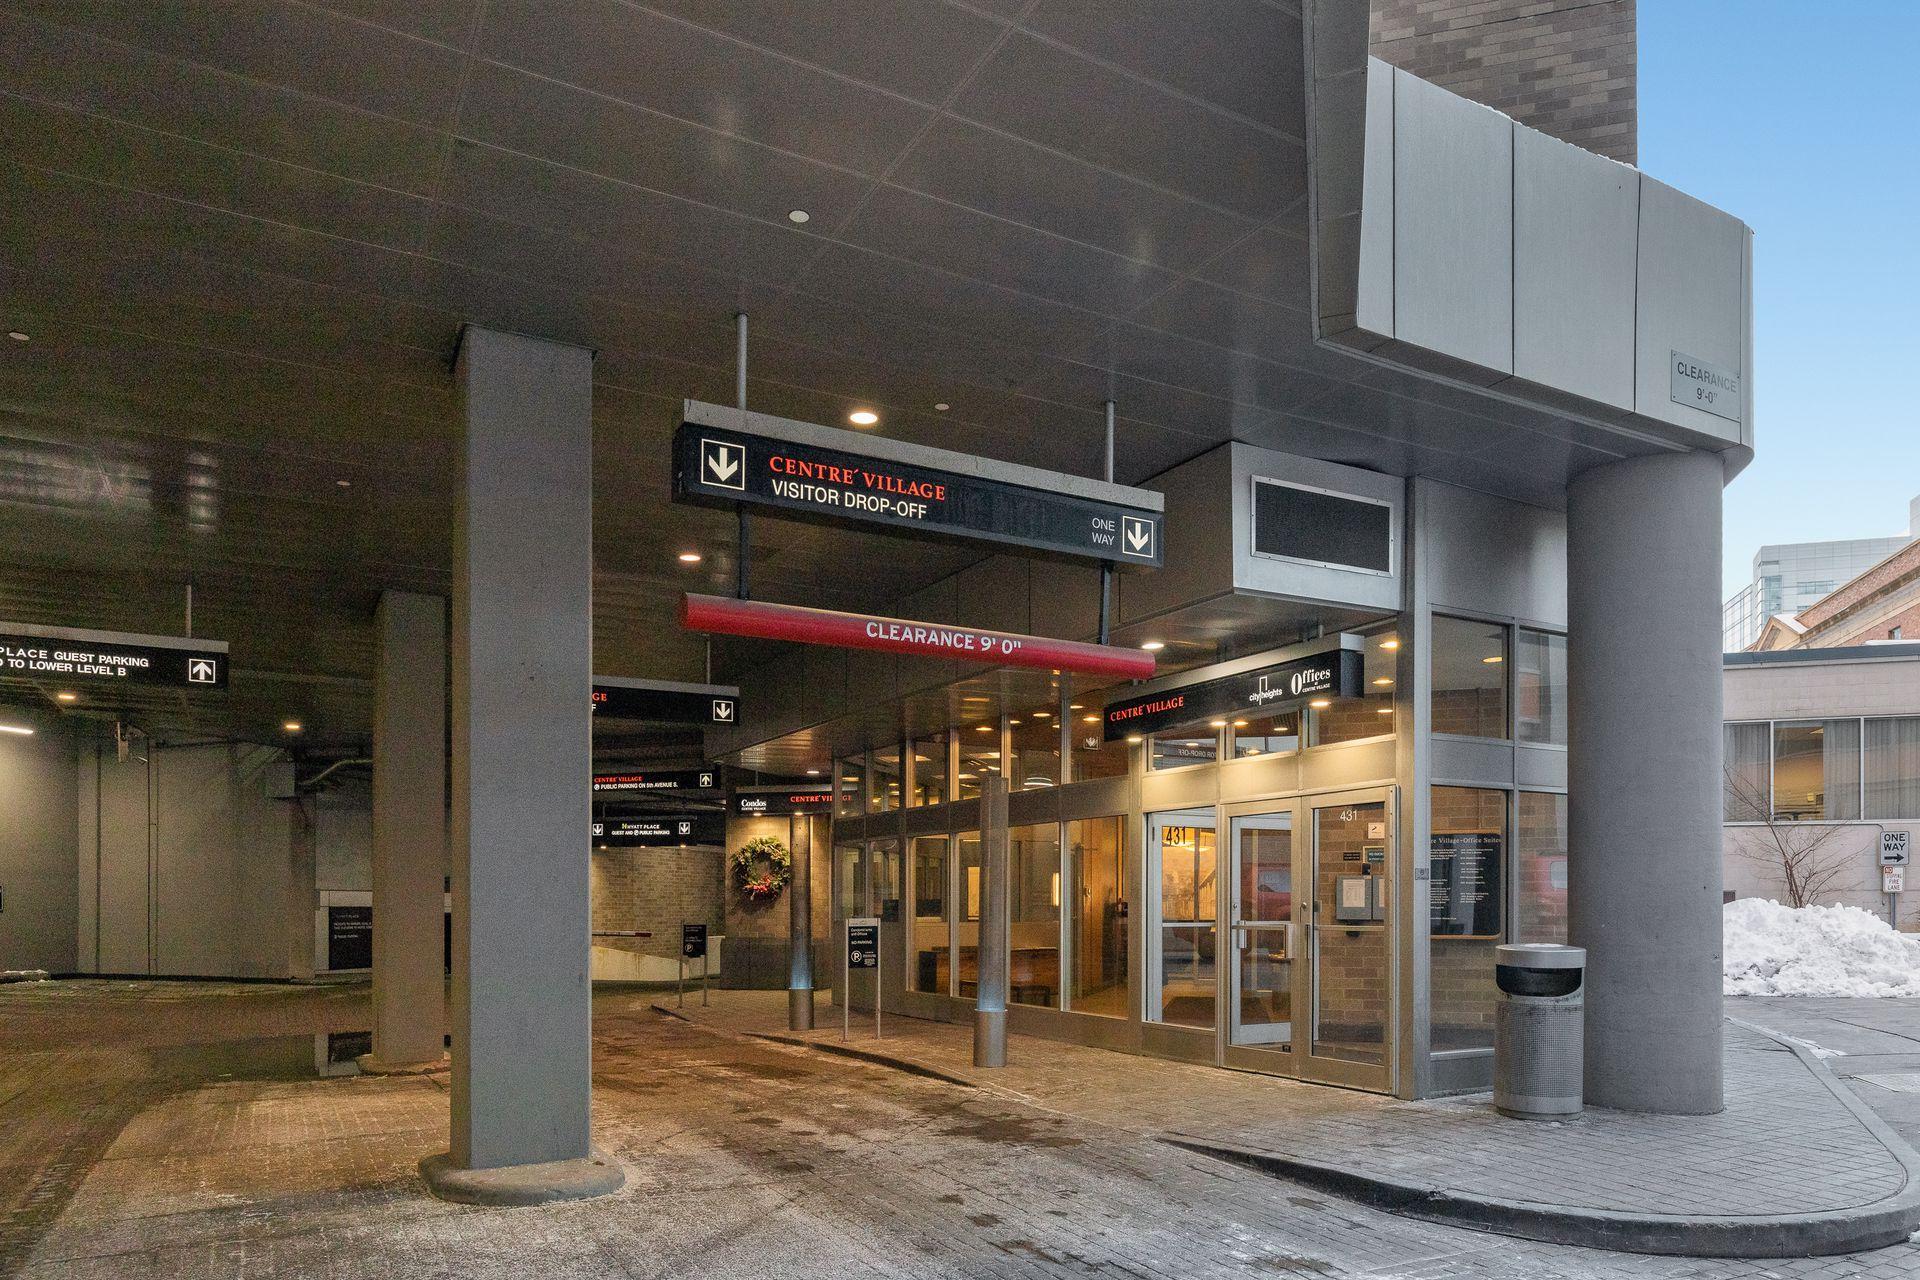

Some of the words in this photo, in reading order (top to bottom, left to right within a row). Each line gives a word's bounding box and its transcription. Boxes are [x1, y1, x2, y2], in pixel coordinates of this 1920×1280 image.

[1677, 361, 1737, 393] CLEARANCE
[862, 471, 945, 501] VILLAGE
[772, 479, 839, 505] VISITOR
[844, 491, 927, 519] DROP-OFF
[1091, 517, 1116, 532] ONE
[1091, 531, 1115, 546] WAY
[865, 621, 975, 650] CLEARANCE
[7, 658, 25, 669] TO
[29, 660, 73, 672] LOWER
[77, 664, 114, 676] LEVEL
[117, 667, 127, 676] B
[54, 651, 95, 663] GUEST
[98, 654, 149, 667] PARKING
[1290, 669, 1331, 695] Offices
[1146, 696, 1184, 714] VILLAGE
[741, 799, 767, 808] Condos
[1339, 810, 1358, 822] 431
[1166, 826, 1186, 846] 431
[1884, 833, 1906, 842] ONE
[1883, 843, 1906, 851] WAY
